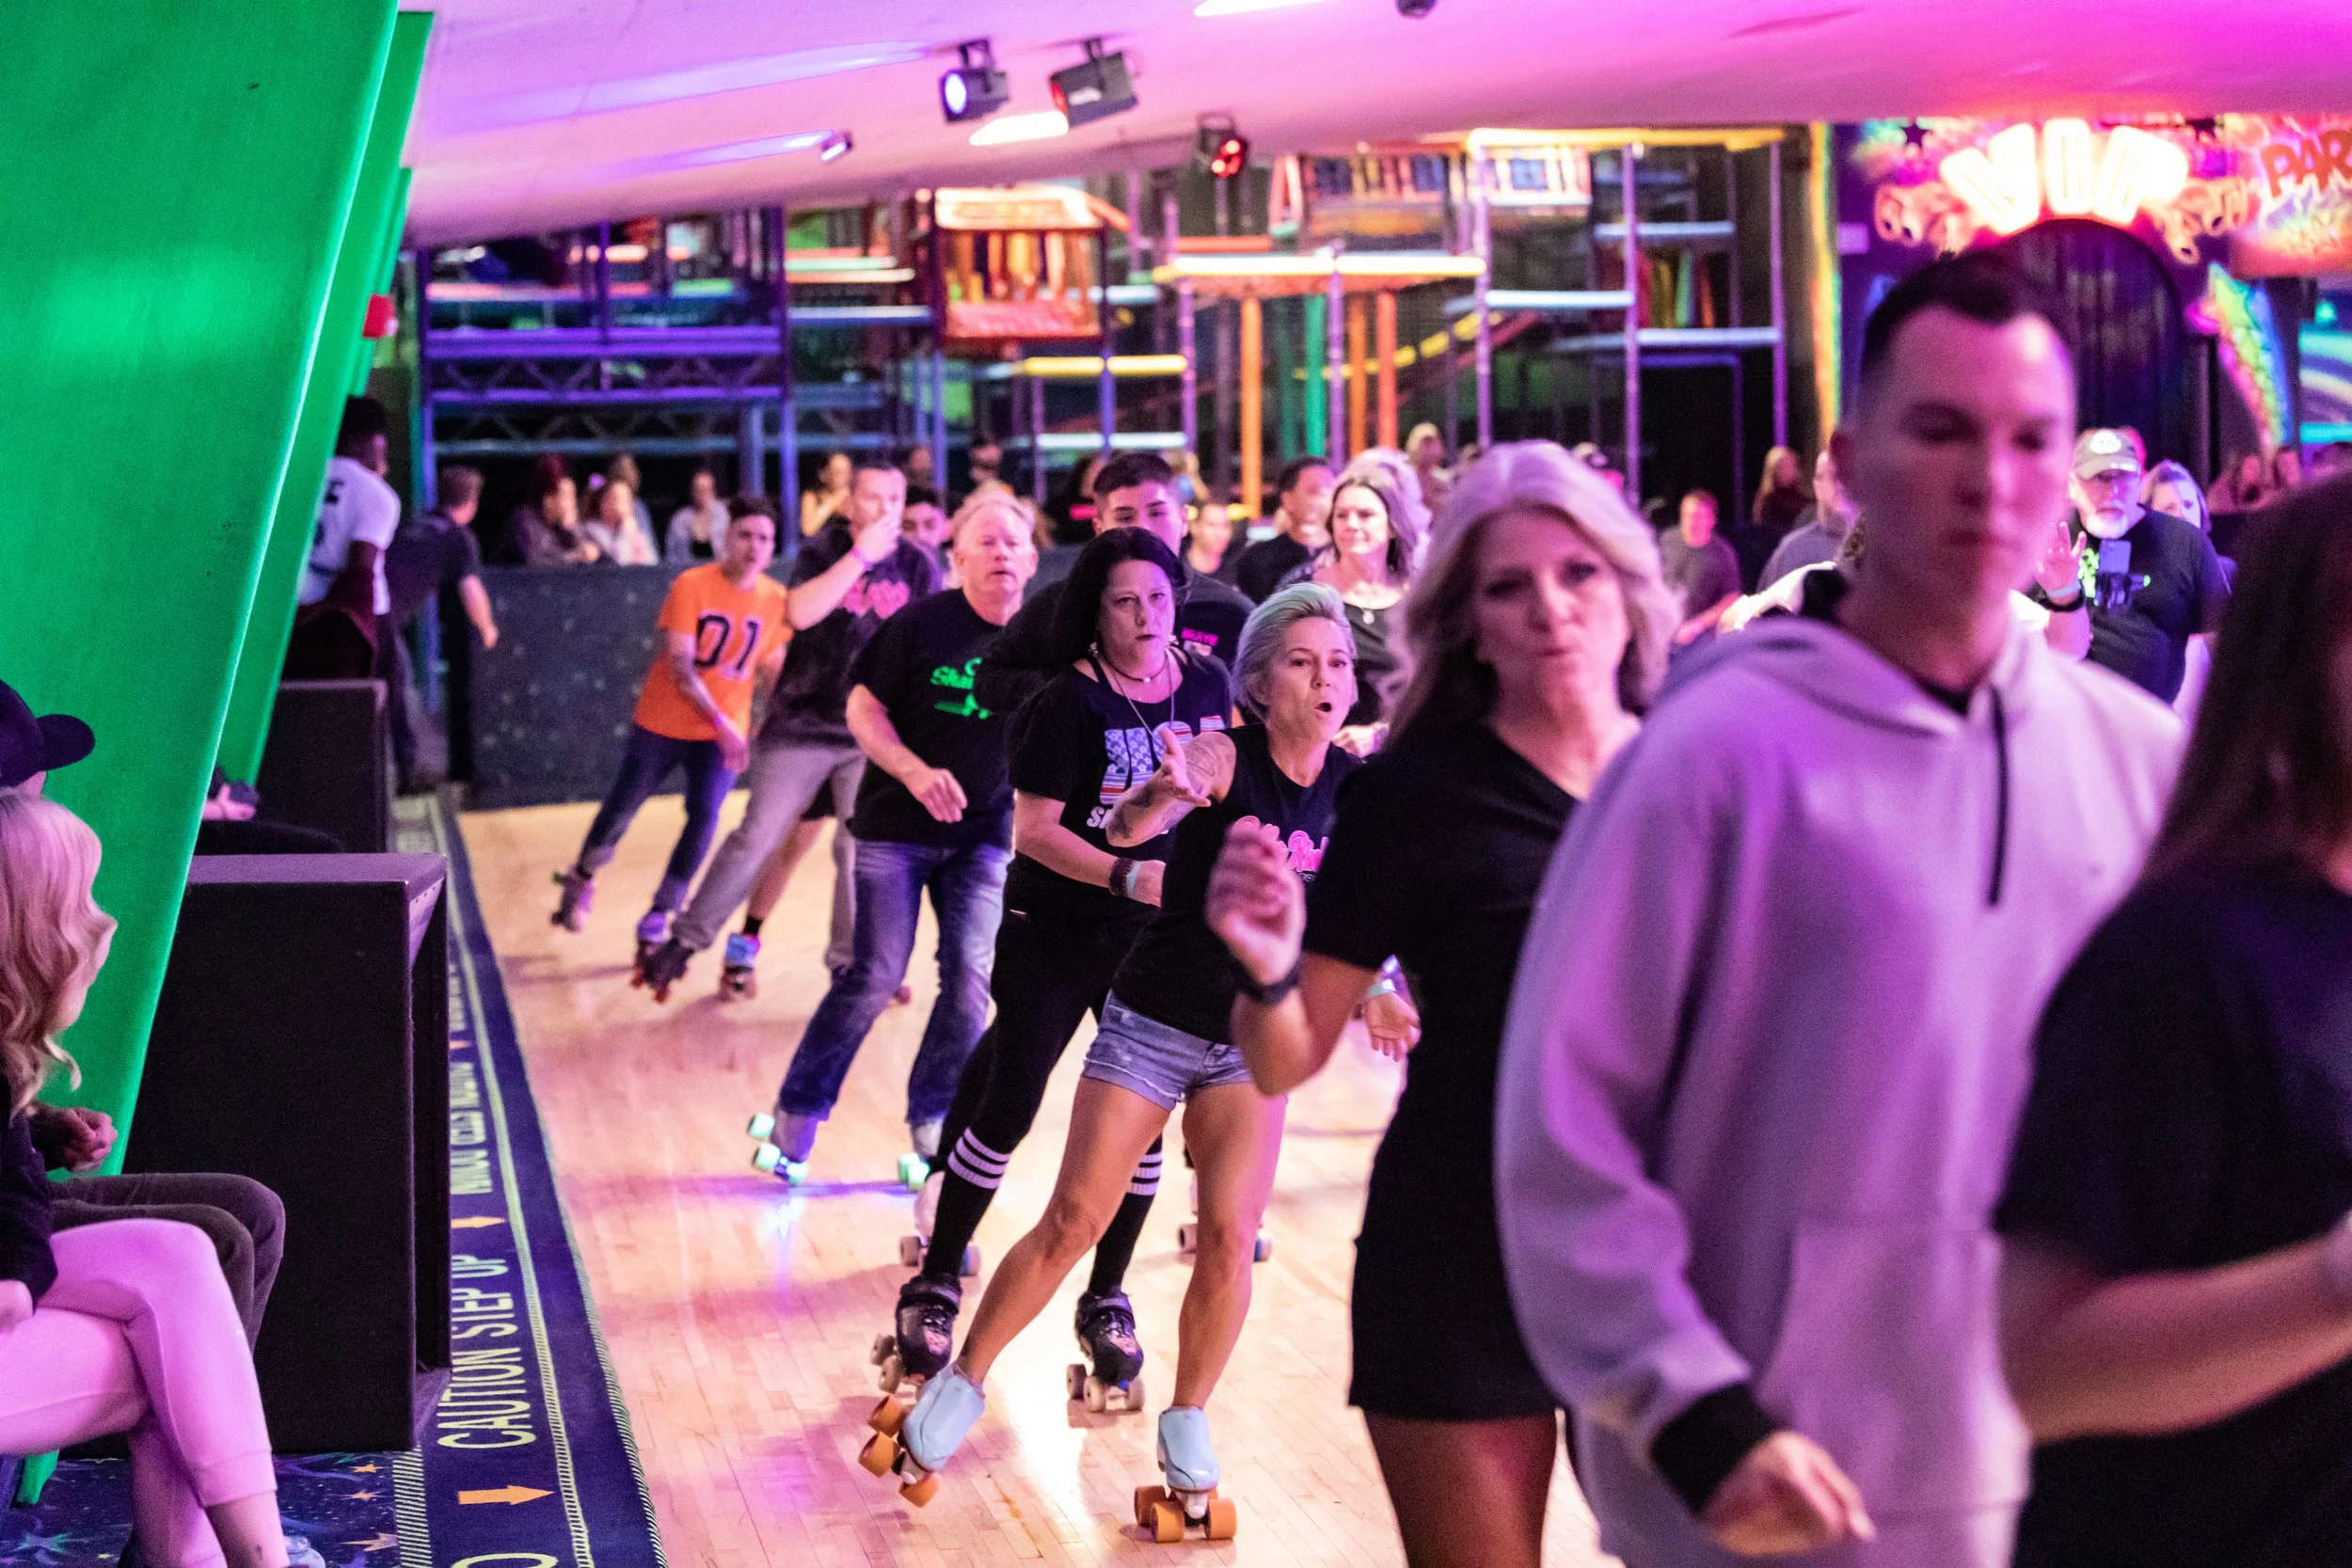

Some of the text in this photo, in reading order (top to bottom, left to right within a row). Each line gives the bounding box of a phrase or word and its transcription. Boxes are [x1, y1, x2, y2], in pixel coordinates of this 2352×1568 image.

[1940, 119, 2187, 233] VIP
[451, 1254, 509, 1279] UP
[451, 1287, 518, 1339] STEP
[437, 1348, 537, 1449] CAUTION
